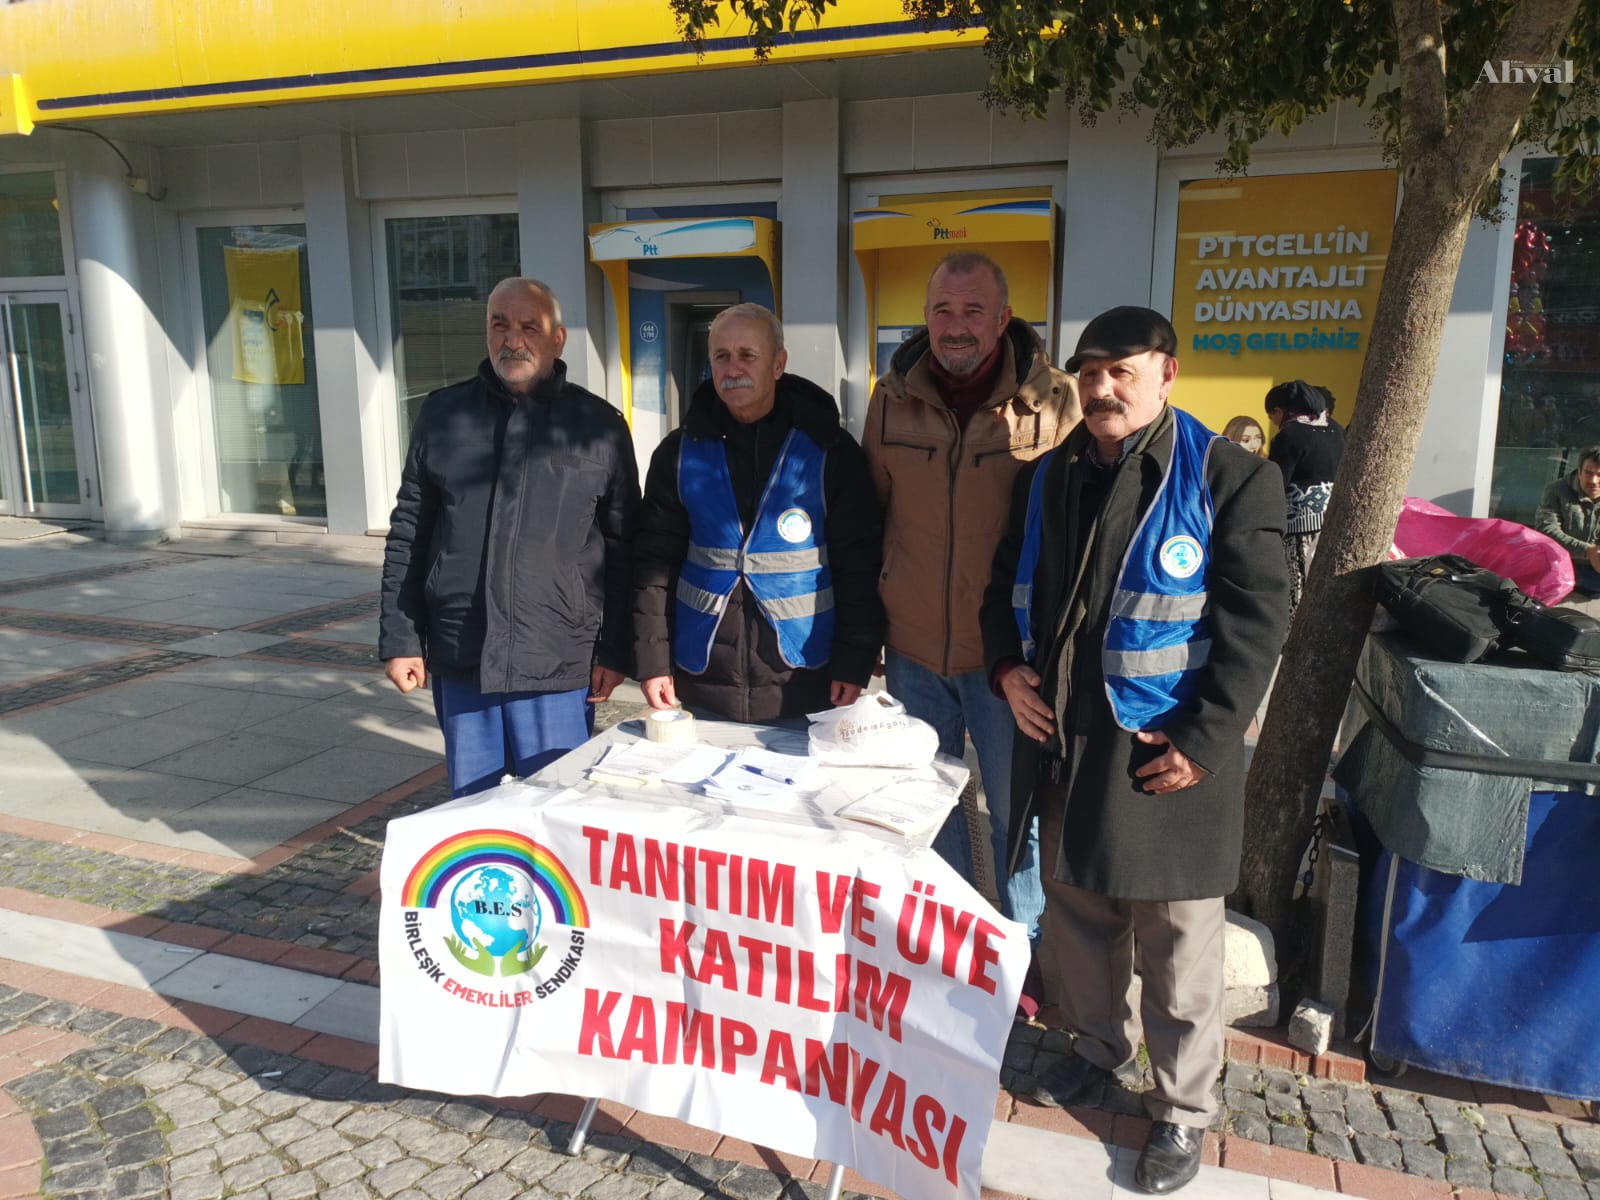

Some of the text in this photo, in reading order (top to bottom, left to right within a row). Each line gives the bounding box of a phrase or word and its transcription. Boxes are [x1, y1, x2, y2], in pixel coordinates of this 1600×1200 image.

[643, 244, 659, 256] Ptt
[1195, 265, 1365, 290] AVANTAJLI
[1194, 296, 1362, 322] DÜNYASINA
[1193, 327, 1361, 356] HOŞ GELDİNİZ
[474, 899, 523, 917] B.E.S
[582, 825, 1007, 996] TANITIM VE ÜYE
[404, 911, 585, 1008] BİRLEŞİK EMEKLİLER SENDİKASI
[659, 917, 912, 1044] KATILIM
[577, 987, 968, 1189] KAMPANYASI
